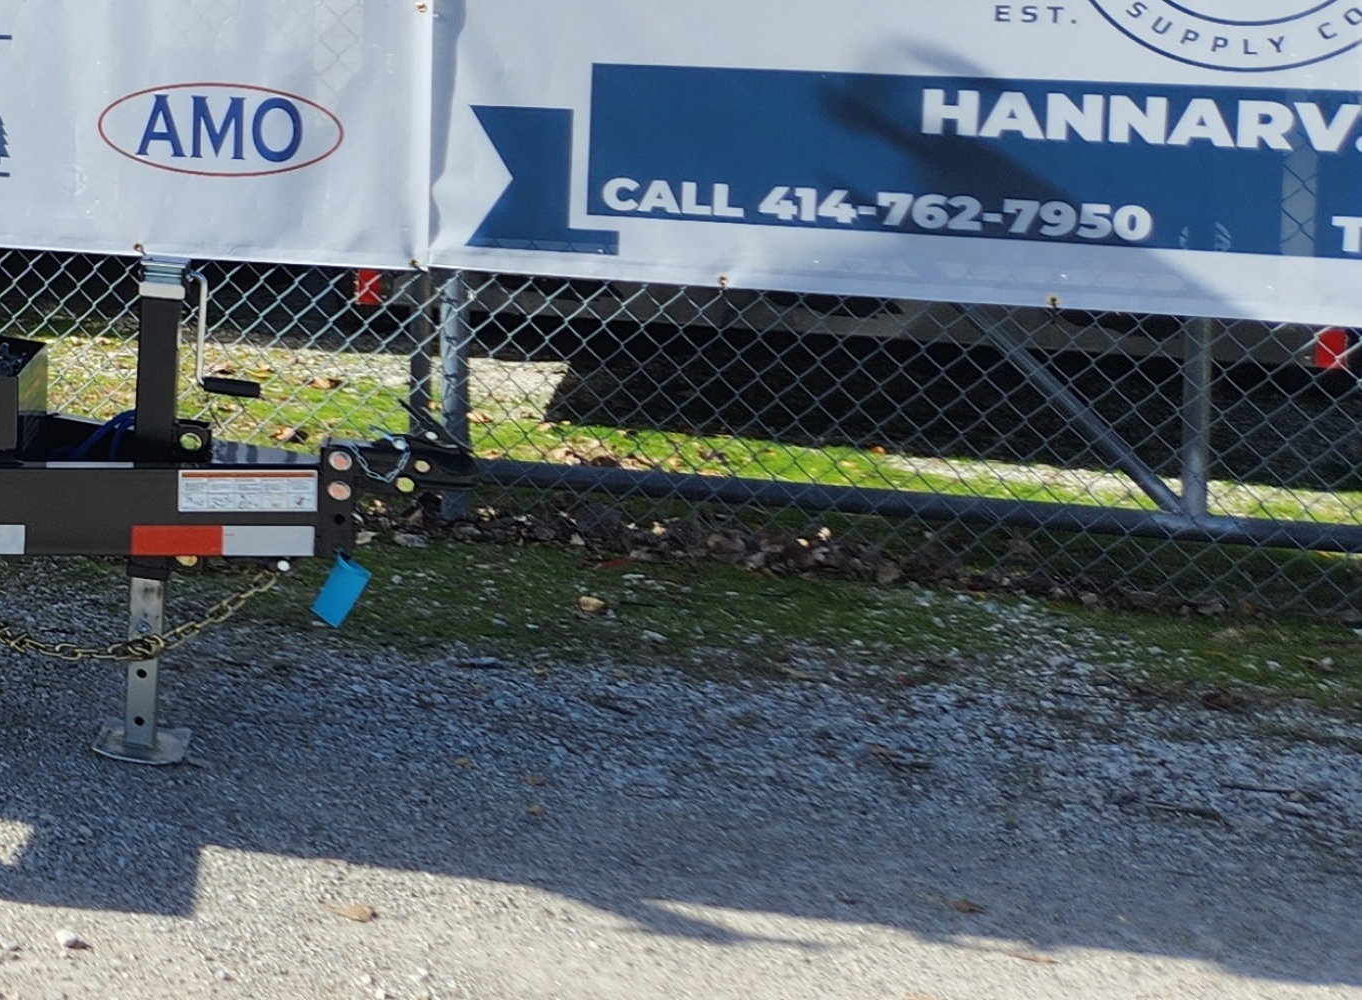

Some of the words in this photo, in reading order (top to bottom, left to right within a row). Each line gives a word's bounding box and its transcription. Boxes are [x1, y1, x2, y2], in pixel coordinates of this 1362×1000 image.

[994, 3, 1078, 25] EST.
[1125, 0, 1286, 55] SUPPLY
[135, 93, 303, 163] AMO
[601, 177, 744, 218] CALL
[758, 184, 1153, 242] 414-762-7950
